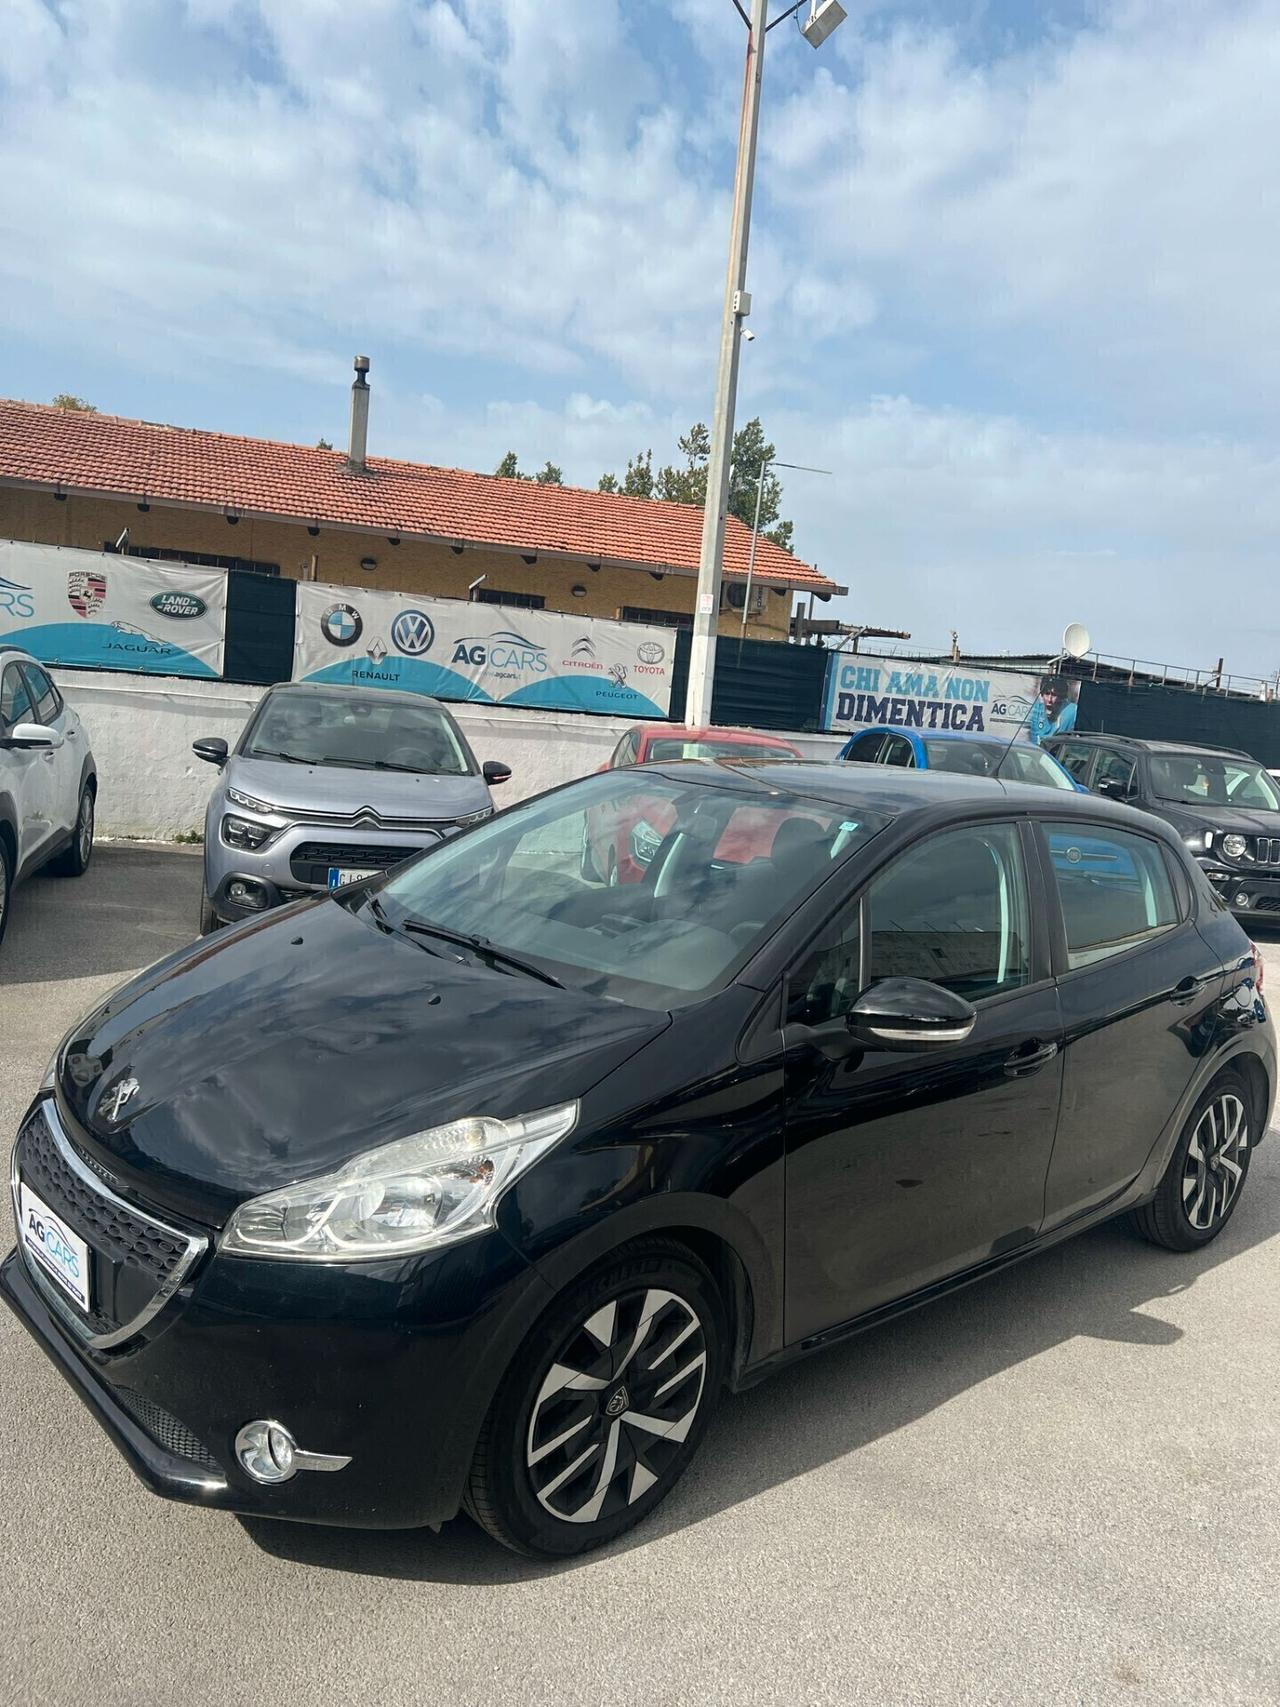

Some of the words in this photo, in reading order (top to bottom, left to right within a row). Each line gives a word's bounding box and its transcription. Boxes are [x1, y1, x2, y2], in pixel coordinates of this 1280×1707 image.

[161, 595, 190, 606] LAND
[162, 604, 198, 615] ROVER
[101, 643, 171, 655] JAGUAR
[352, 670, 400, 682] RENAULT
[633, 665, 666, 676] TOYOTA
[840, 665, 880, 693] CHI
[886, 672, 940, 697] AMA
[945, 678, 991, 702] NON
[595, 690, 639, 700] PEUGEOT
[836, 692, 985, 731] DIMENTICA
[991, 703, 1007, 715] AG
